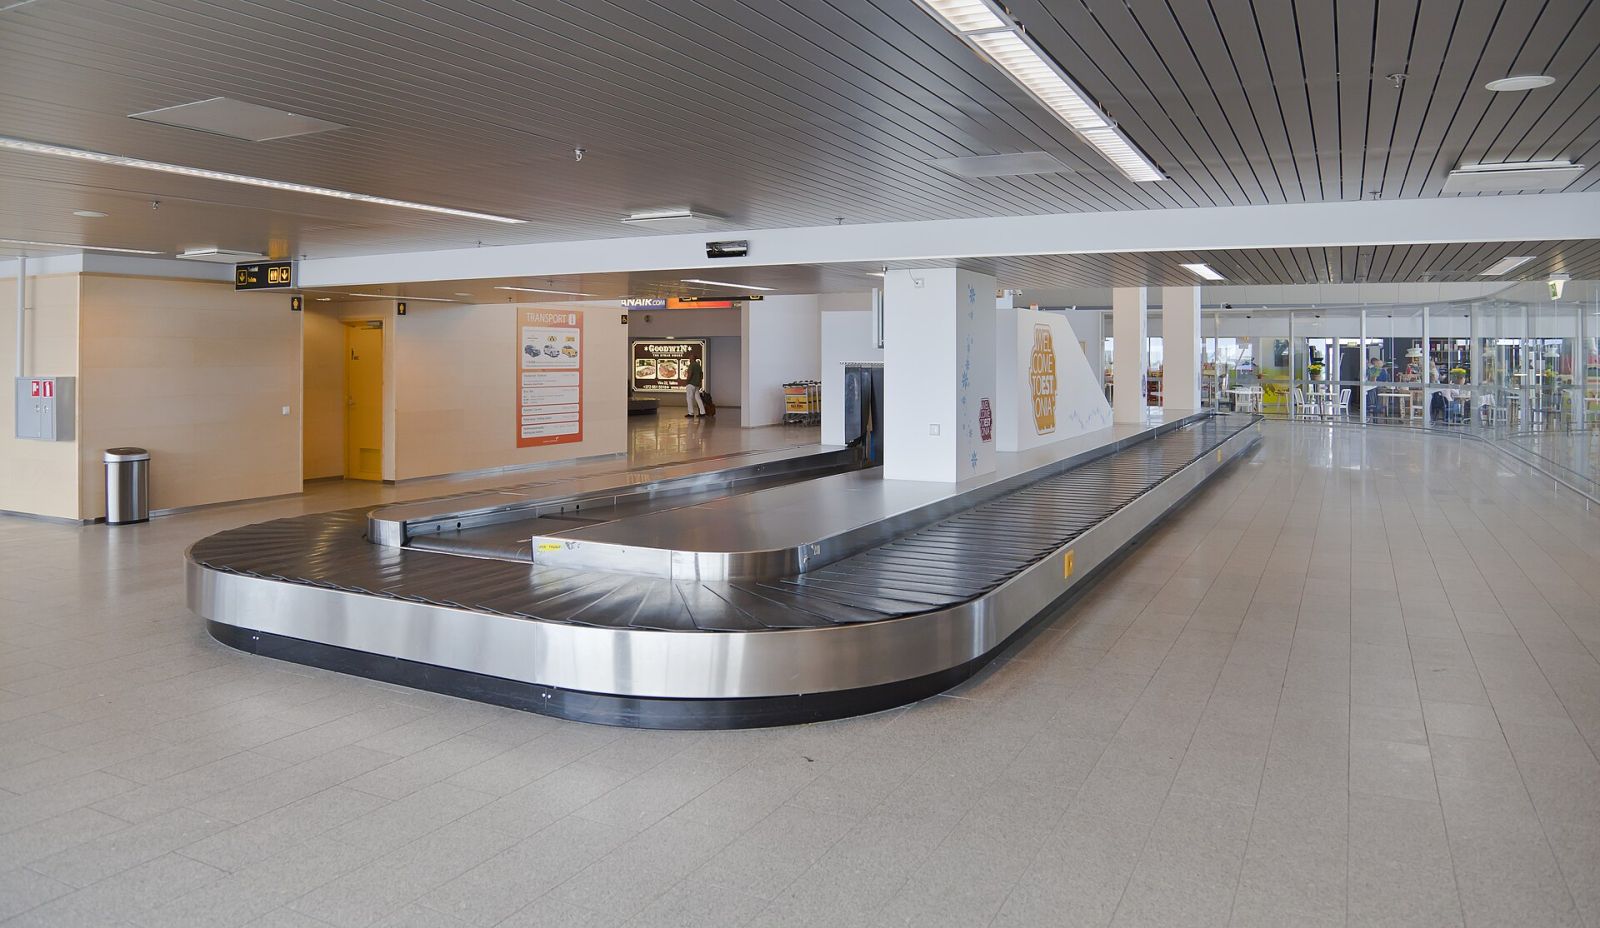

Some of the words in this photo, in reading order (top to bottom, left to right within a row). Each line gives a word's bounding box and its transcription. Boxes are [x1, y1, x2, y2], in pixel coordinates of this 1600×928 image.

[527, 312, 567, 323] TRANSPORT
[1034, 329, 1051, 352] WEL
[1032, 353, 1053, 373] COME
[1035, 397, 1052, 417] ONIA
